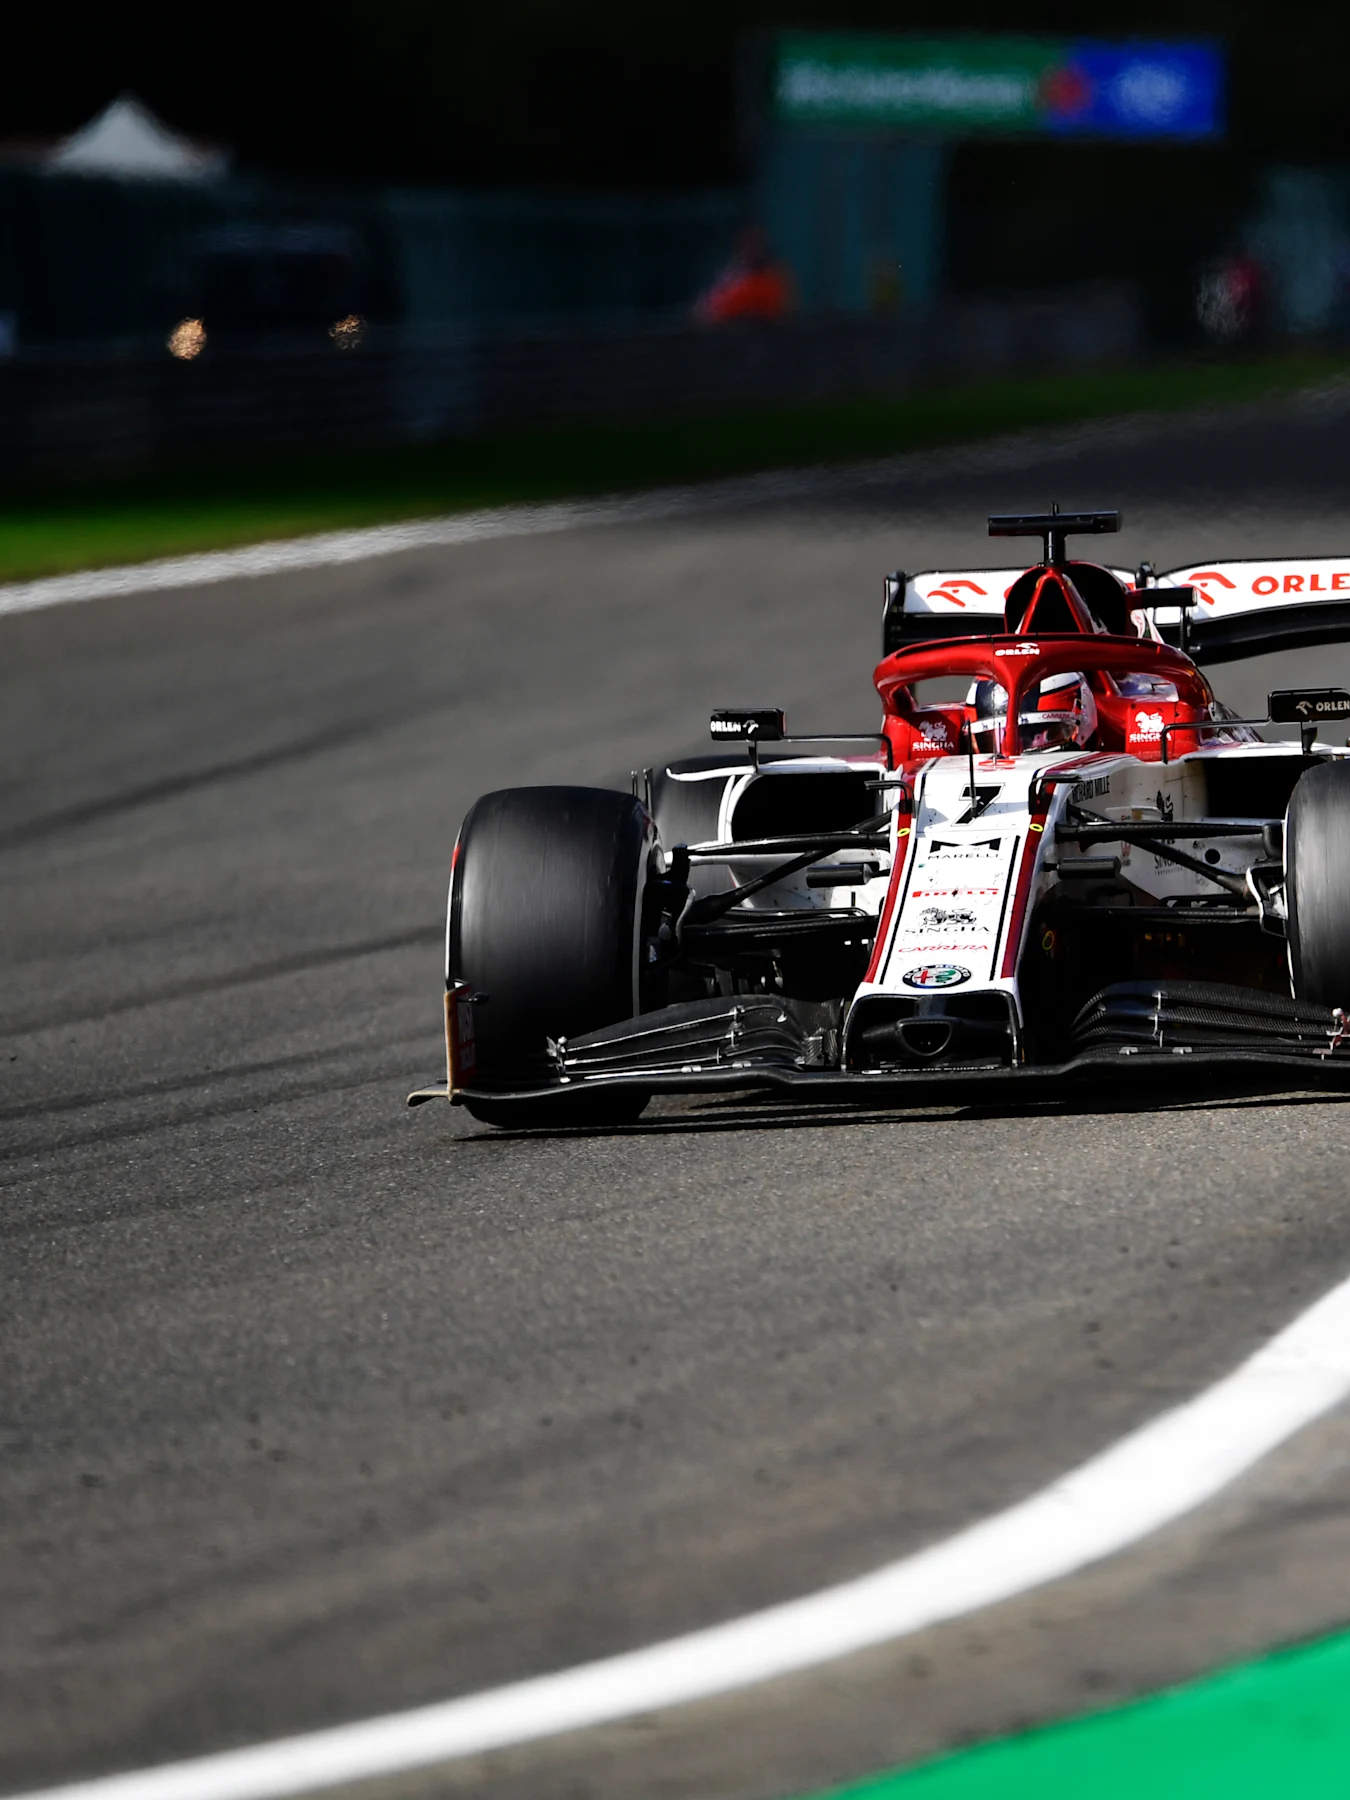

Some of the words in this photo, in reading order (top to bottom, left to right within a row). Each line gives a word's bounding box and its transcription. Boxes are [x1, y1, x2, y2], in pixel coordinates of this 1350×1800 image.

[994, 647, 1041, 657] ORLEN
[1315, 700, 1350, 712] ORLEN
[710, 721, 741, 732] ORLEN
[912, 741, 955, 750] SINGHA
[1095, 774, 1111, 797] MILLE
[950, 782, 1005, 828] 7
[928, 853, 998, 861] MARELLI
[905, 926, 990, 934] SINGHA
